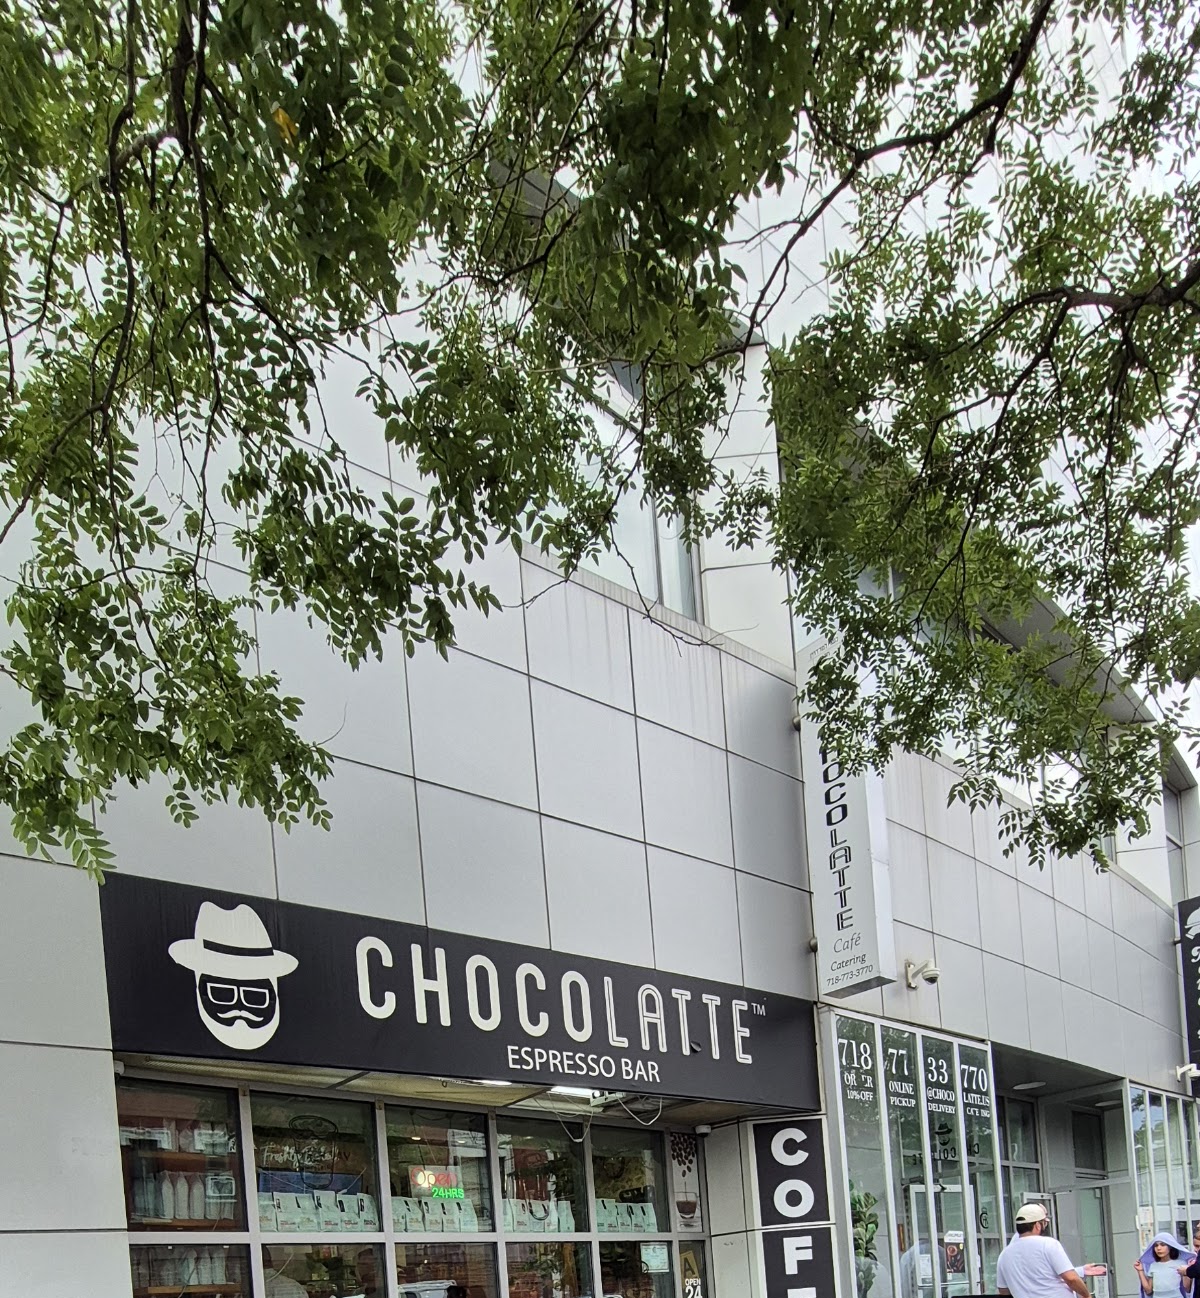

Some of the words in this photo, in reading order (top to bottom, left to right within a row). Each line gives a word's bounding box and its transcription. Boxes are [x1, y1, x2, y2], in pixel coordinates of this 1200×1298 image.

[833, 932, 861, 953] Café
[830, 953, 867, 972] Catering
[826, 964, 874, 987] 718-773-3770
[355, 936, 753, 1065] CHOCOLATTE
[507, 1045, 616, 1078] ESPRESSO
[622, 1058, 661, 1083] BAR
[837, 1038, 872, 1070] 718
[888, 1047, 909, 1076] 77
[927, 1057, 949, 1084] 33
[960, 1064, 988, 1092] 770
[888, 1080, 914, 1095] ONLINE
[889, 1096, 916, 1108] PICKUP
[927, 1102, 956, 1114] DELIVERY
[411, 1167, 458, 1190] Open
[431, 1187, 465, 1199] 24HRS
[684, 1278, 701, 1286] OPEN
